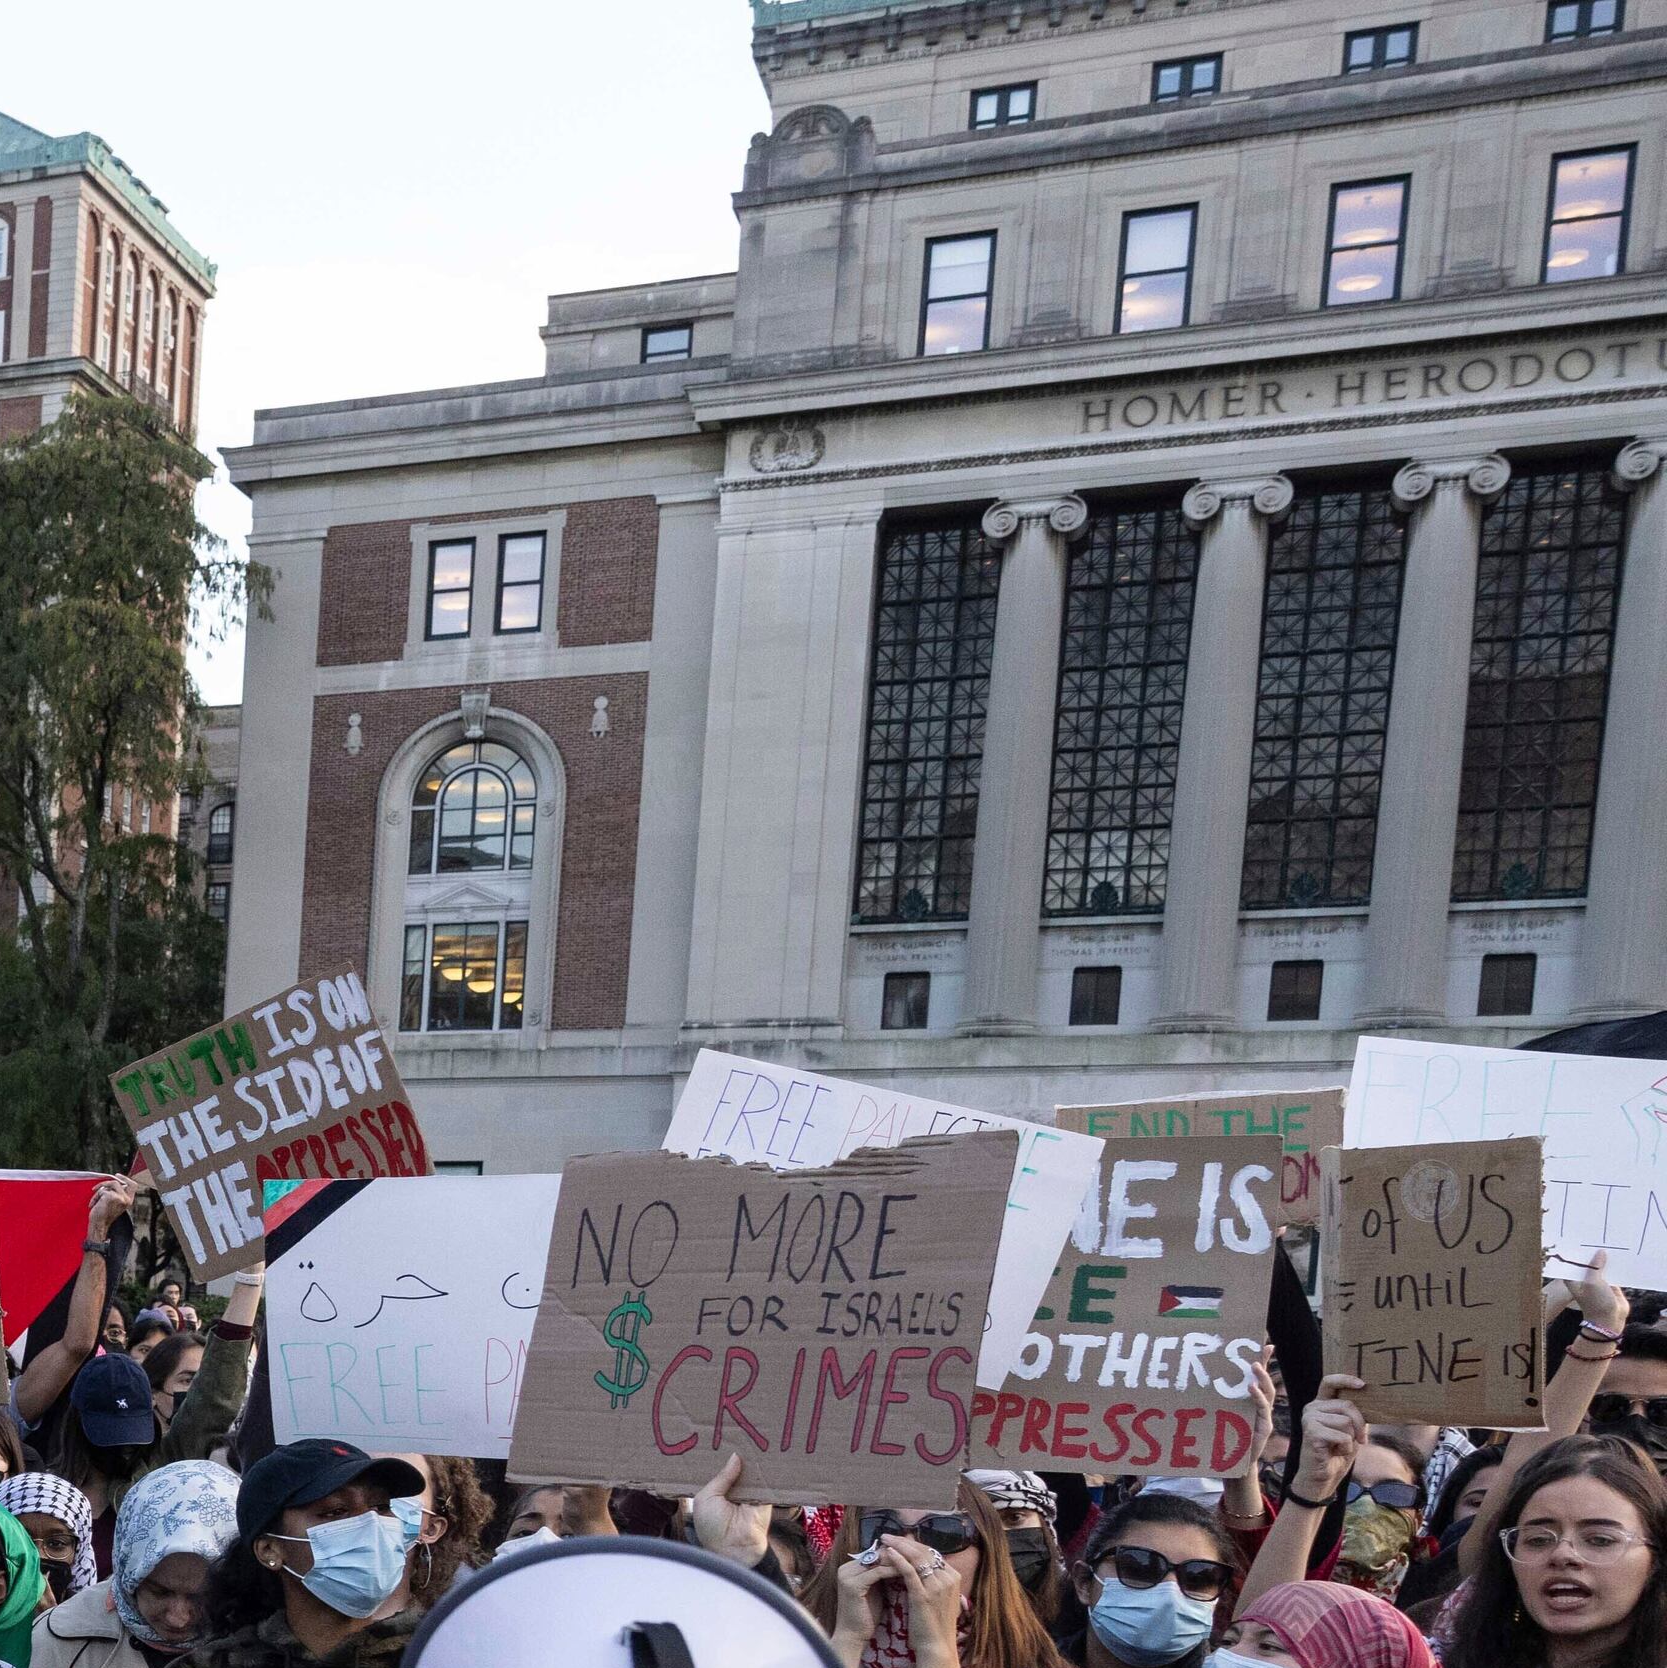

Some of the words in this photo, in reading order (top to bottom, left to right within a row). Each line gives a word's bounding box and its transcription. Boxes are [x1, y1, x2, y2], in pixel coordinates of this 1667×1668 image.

[1081, 380, 1288, 434] HOMER
[117, 1022, 259, 1117] TRUTH
[252, 989, 317, 1058] IS
[318, 972, 372, 1029] ON
[136, 1094, 236, 1181] THE
[702, 1068, 833, 1164] FREE
[1087, 1111, 1191, 1137] END
[1209, 1104, 1312, 1152] THE
[1358, 1050, 1595, 1160] FREE
[161, 1160, 265, 1266] THE
[255, 1100, 427, 1190] OPPRESSED
[1194, 1161, 1274, 1256] IS
[1362, 1177, 1401, 1255] of
[1434, 1174, 1514, 1255] US
[570, 1200, 680, 1290] NO
[725, 1192, 918, 1283] MORE
[299, 1259, 449, 1331] حرة
[279, 1341, 449, 1430] FREE
[593, 1290, 653, 1410] $
[696, 1295, 790, 1336] FOR
[816, 1291, 964, 1337] ISRAEL'S
[1009, 1331, 1264, 1399] OTHERS
[652, 1345, 973, 1467] CRIMES
[971, 1391, 1252, 1472] PPRESSED
